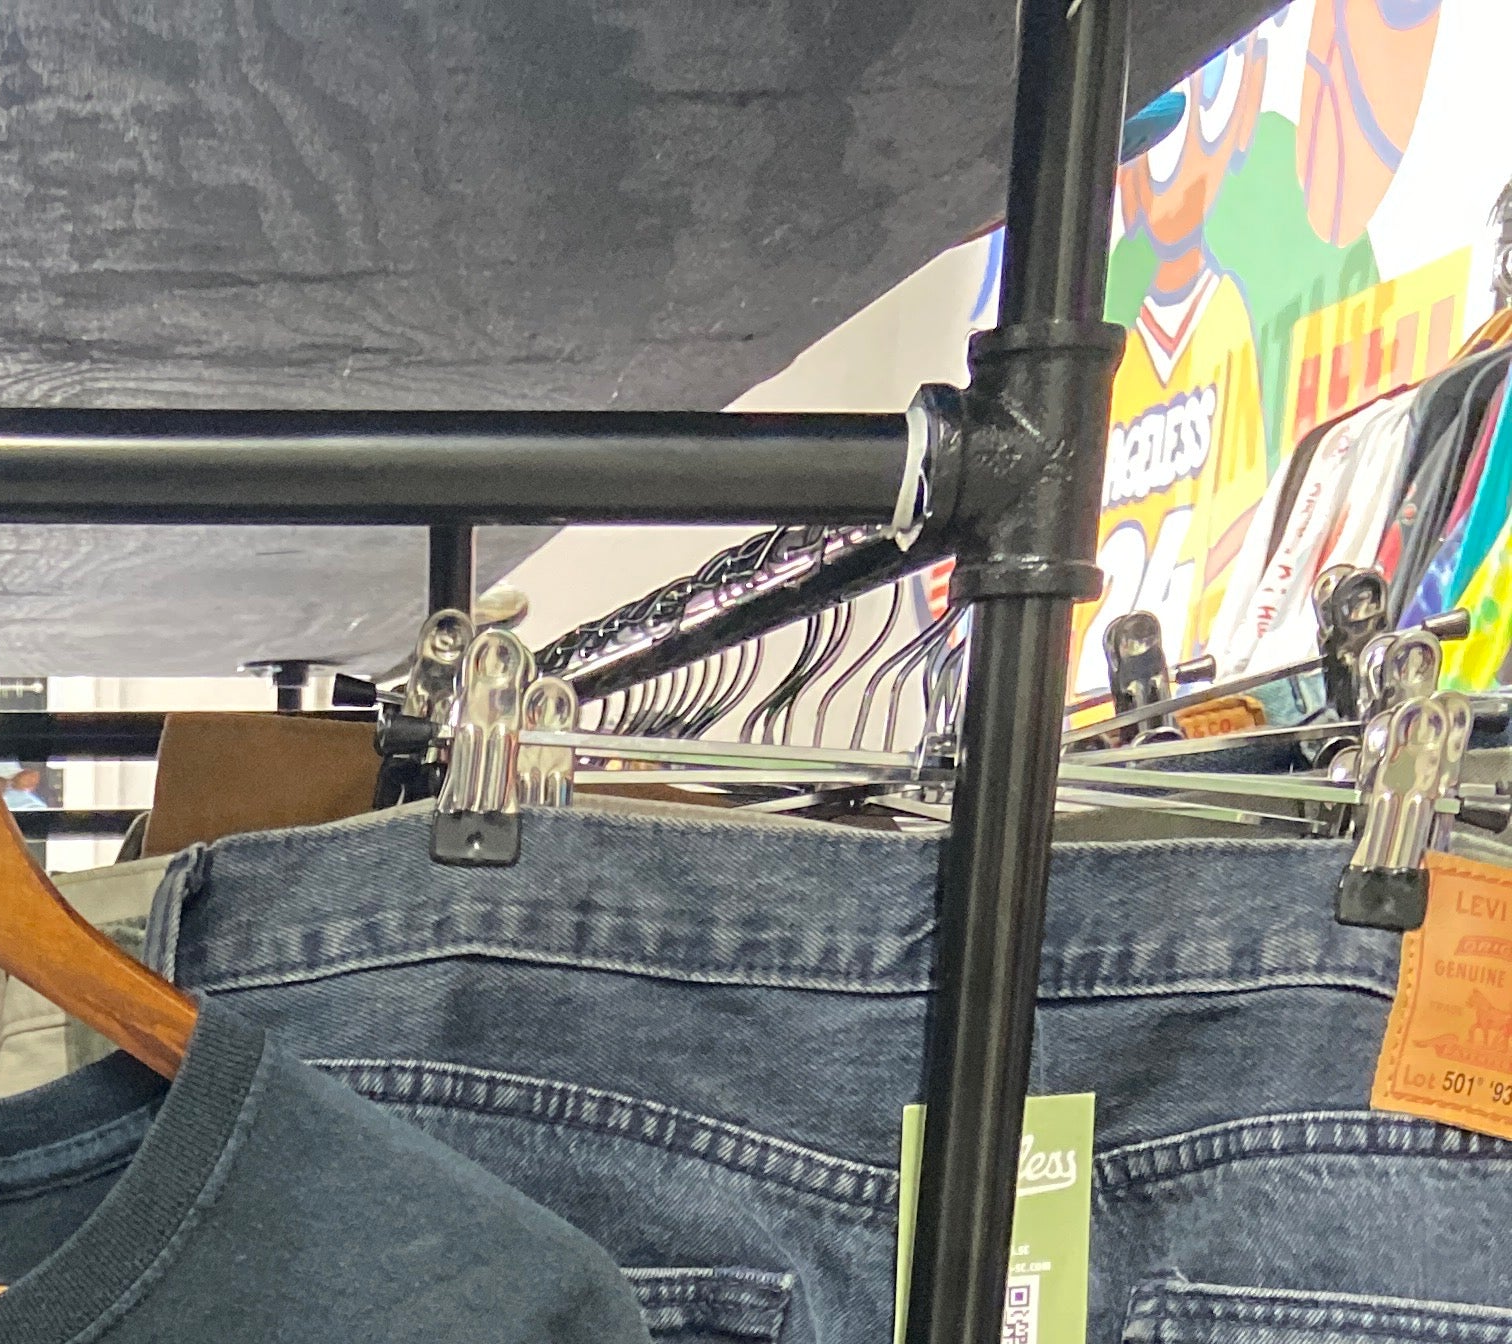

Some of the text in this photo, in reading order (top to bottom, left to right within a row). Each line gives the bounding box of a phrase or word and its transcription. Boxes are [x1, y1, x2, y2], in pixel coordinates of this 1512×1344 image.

[1455, 890, 1507, 923] LEVI
[1434, 959, 1506, 988] GENUINE
[1403, 1063, 1436, 1089] Lot
